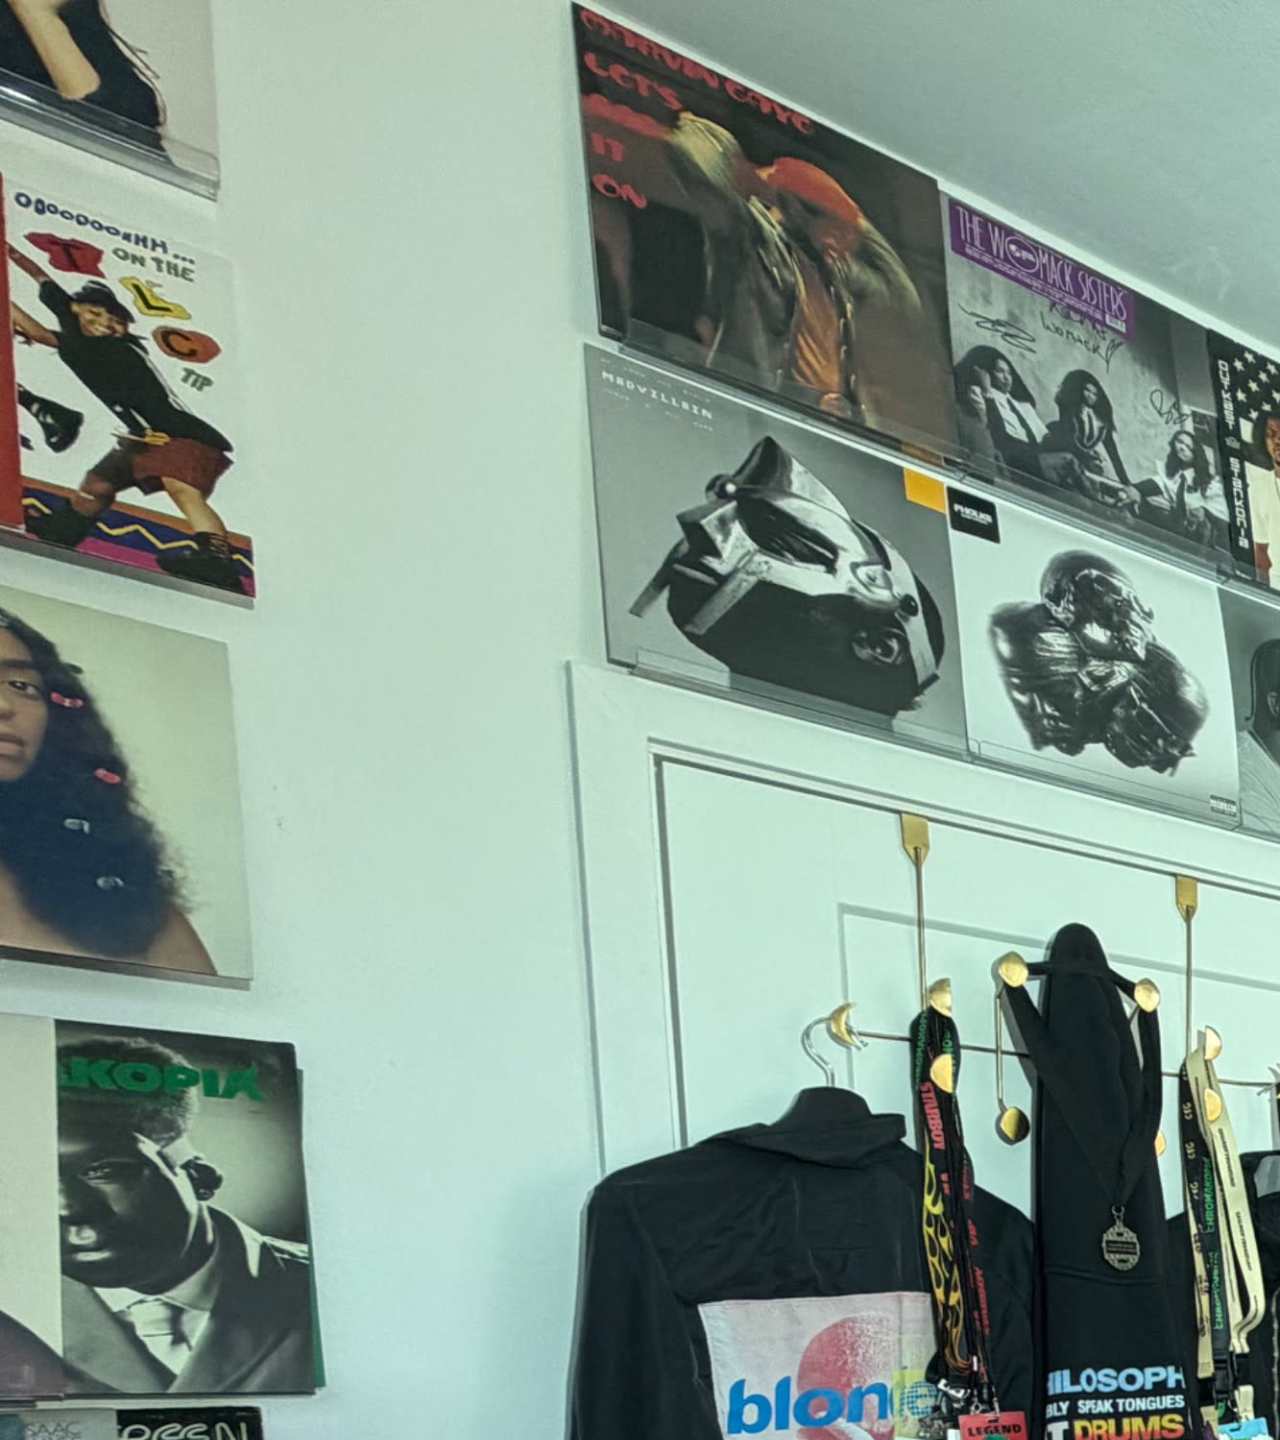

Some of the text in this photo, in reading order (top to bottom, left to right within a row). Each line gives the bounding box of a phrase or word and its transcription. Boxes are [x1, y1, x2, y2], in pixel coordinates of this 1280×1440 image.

[957, 206, 986, 251] THE
[112, 246, 196, 282] ON THE
[180, 366, 214, 392] TIP
[1115, 1394, 1186, 1414] TONGUES
[967, 1423, 1023, 1438] LEGEND
